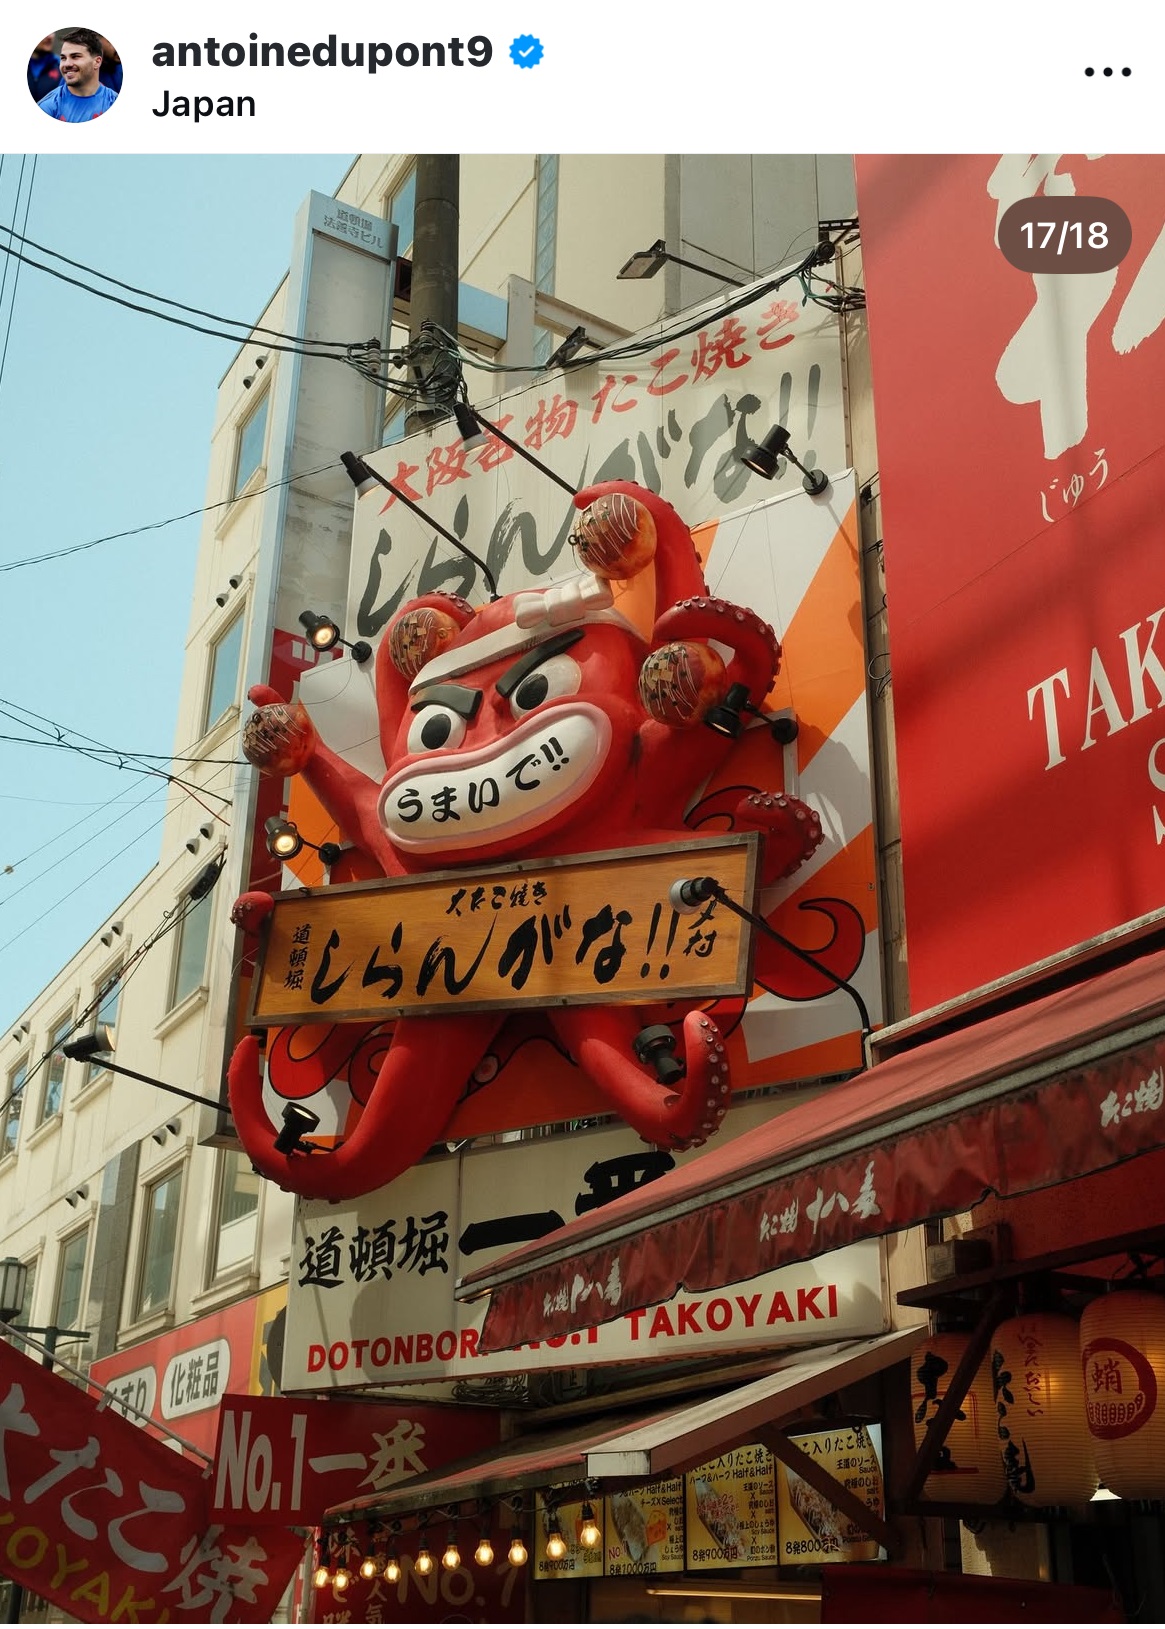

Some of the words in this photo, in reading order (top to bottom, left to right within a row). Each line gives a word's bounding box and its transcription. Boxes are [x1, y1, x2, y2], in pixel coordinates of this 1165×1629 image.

[1040, 447, 1109, 523] じゅう
[1026, 606, 1165, 772] TAK
[397, 736, 570, 823] うまいで!!
[284, 923, 312, 991] 道頓堀
[307, 1329, 489, 1373] DOTONBOR
[624, 1286, 839, 1342] TAKOYAKI
[170, 1351, 220, 1408] 化粧品
[1092, 1357, 1124, 1395] 蛸
